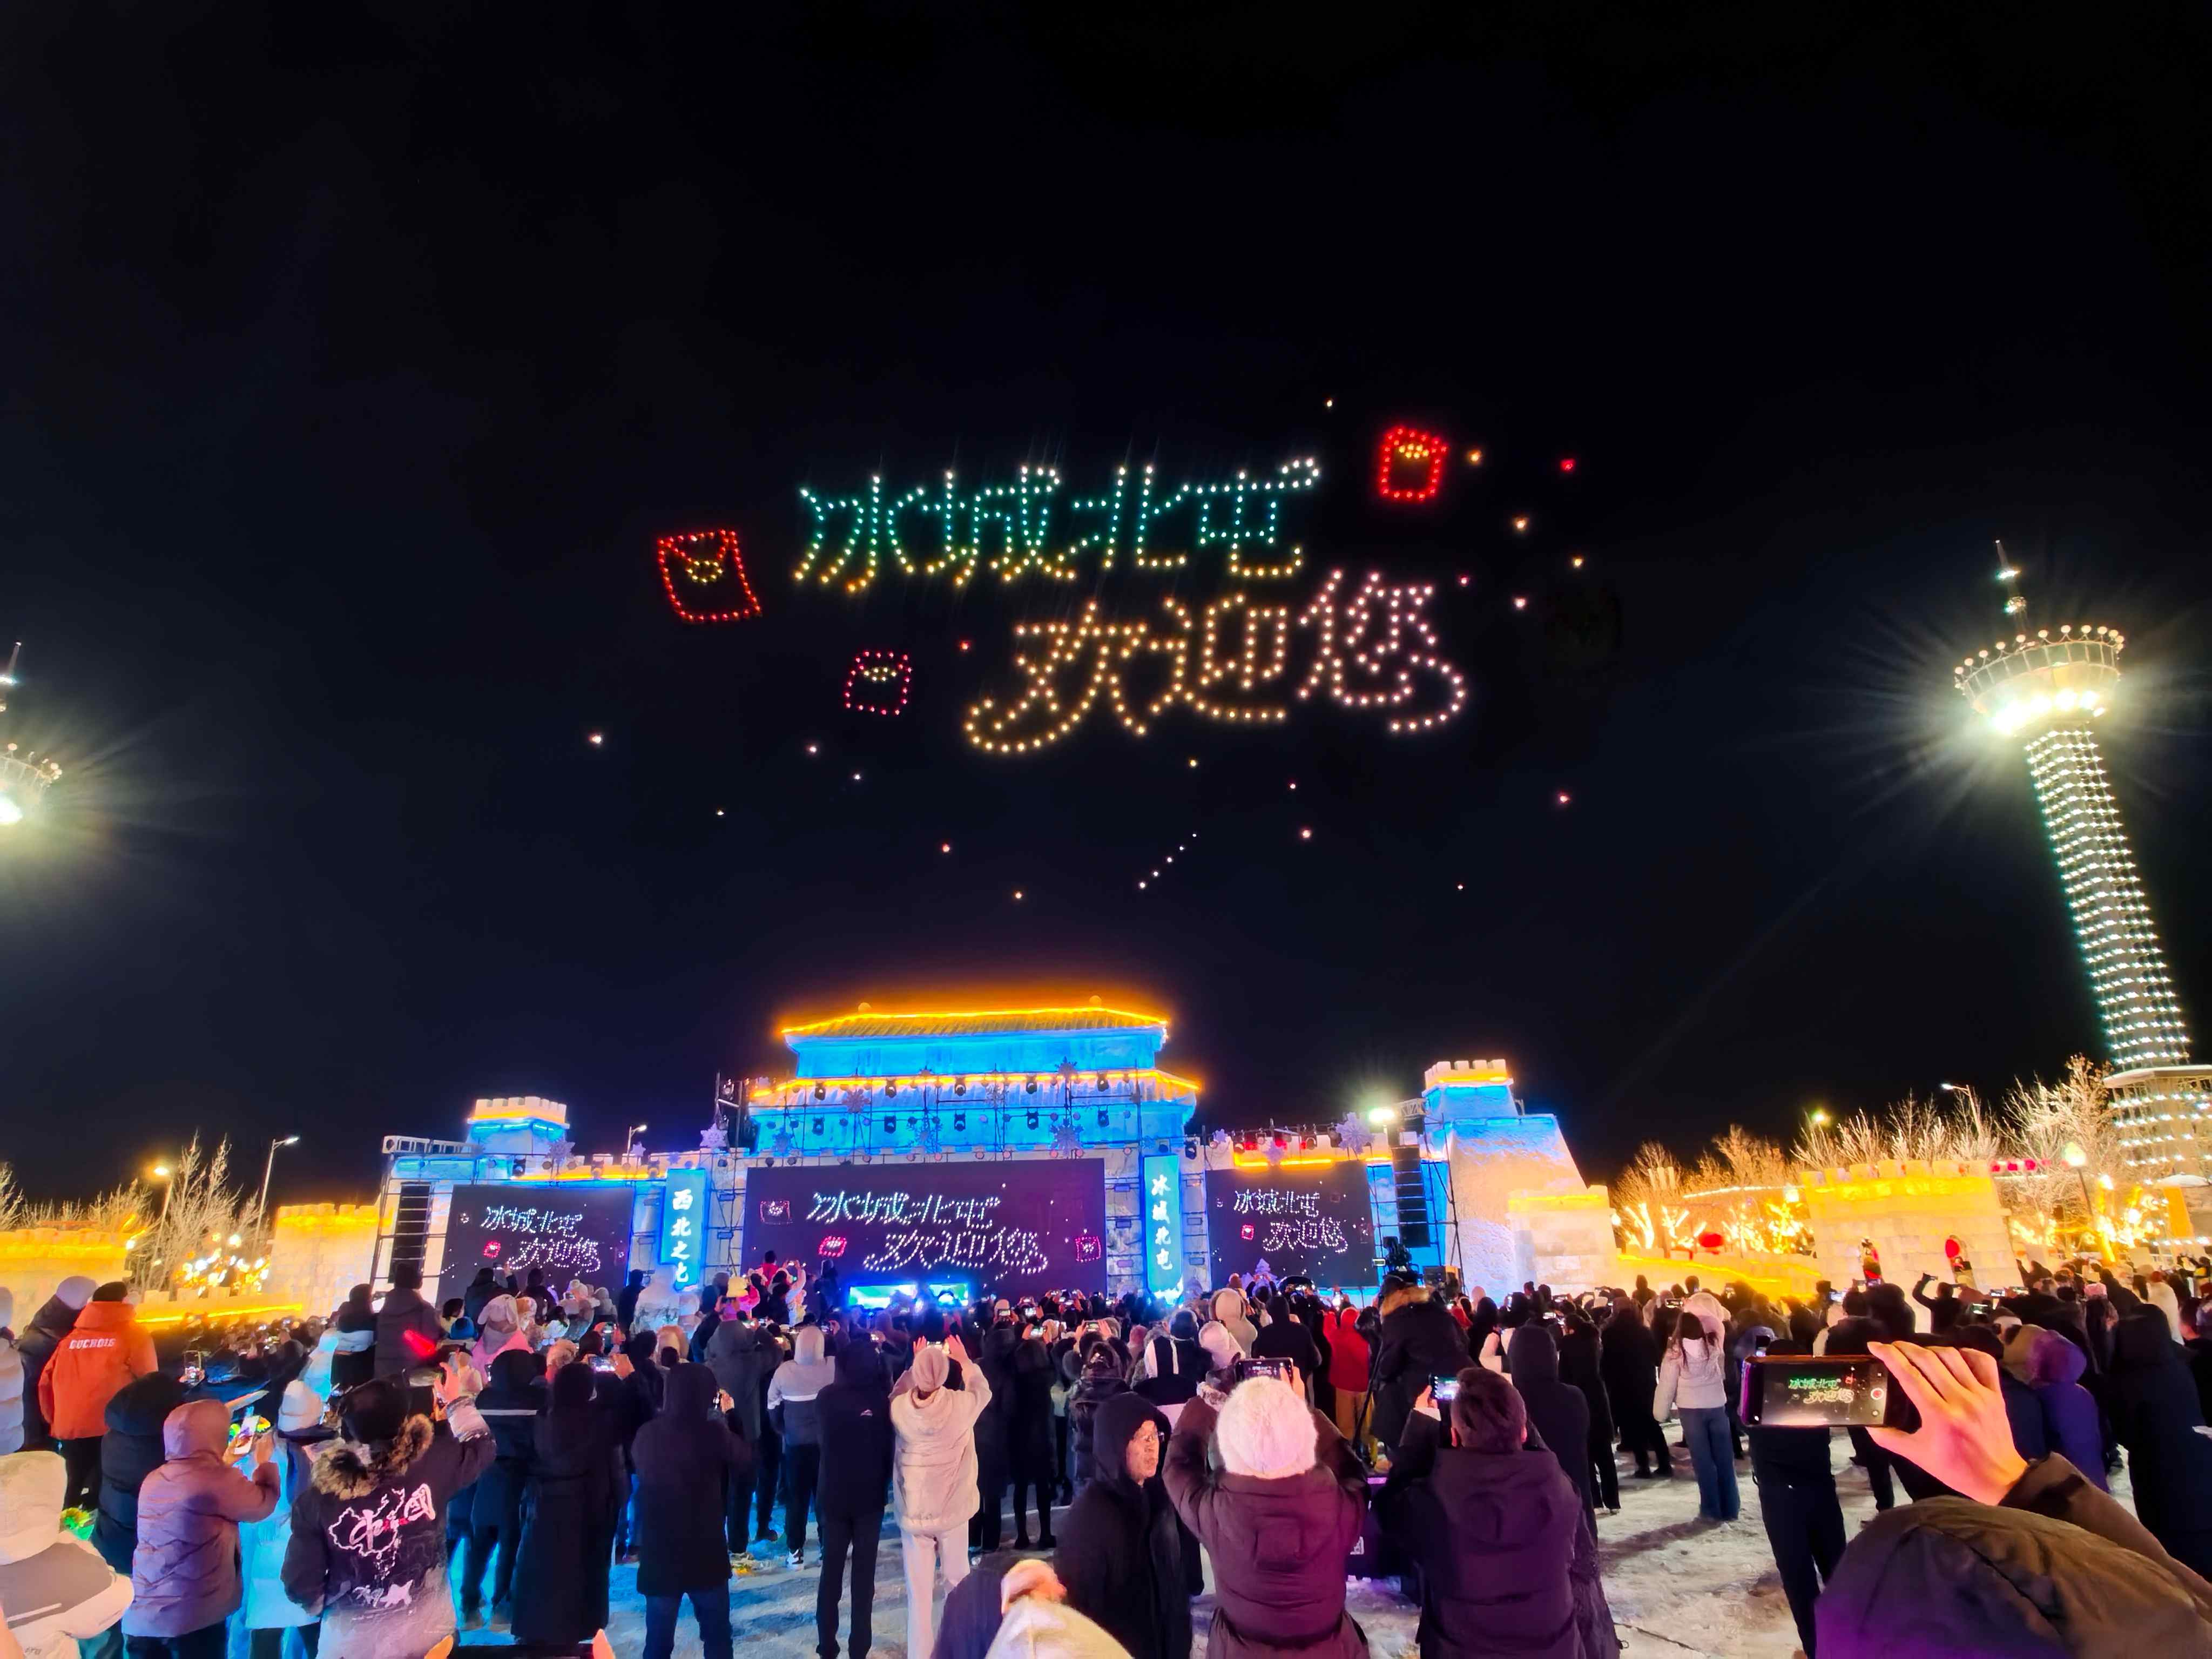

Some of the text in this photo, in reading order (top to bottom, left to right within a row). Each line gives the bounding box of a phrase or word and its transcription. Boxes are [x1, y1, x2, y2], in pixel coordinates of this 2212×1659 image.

[794, 457, 1321, 593] 冰城北屯
[963, 570, 1467, 754] 欢迎您
[480, 1205, 583, 1238] 冰城北屯
[806, 1191, 1001, 1229] 冰城北屯
[1233, 1189, 1320, 1217] 冰城北屯
[863, 1227, 1048, 1274] 欢迎您
[1263, 1217, 1348, 1253] 欢迎您
[507, 1237, 601, 1273] 欢迎您
